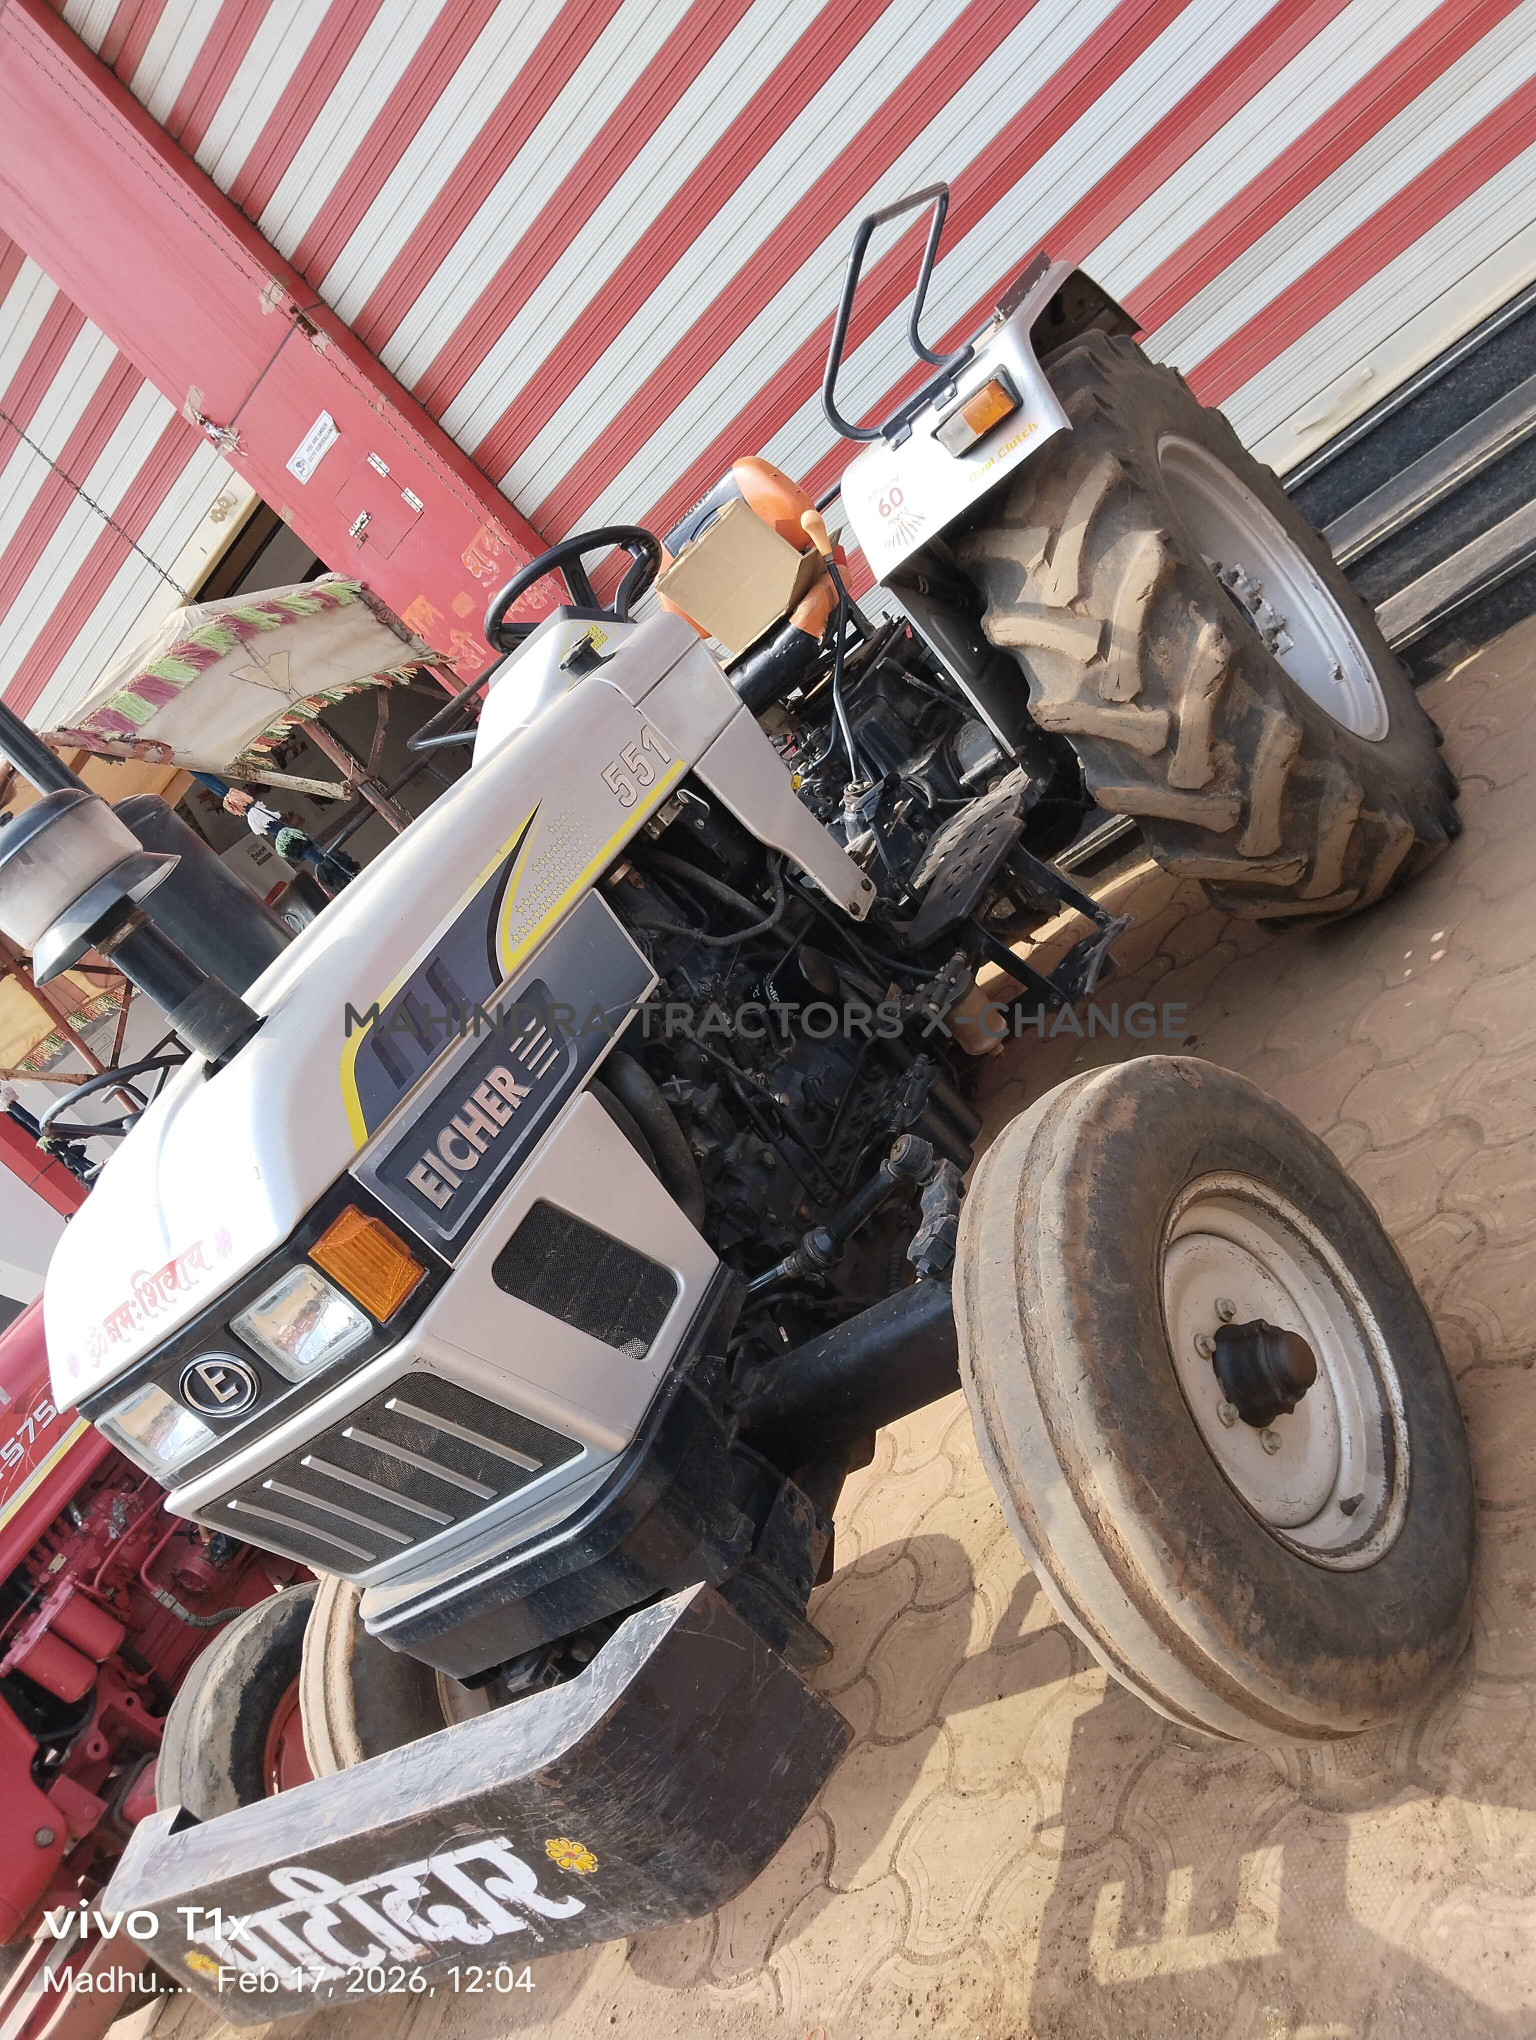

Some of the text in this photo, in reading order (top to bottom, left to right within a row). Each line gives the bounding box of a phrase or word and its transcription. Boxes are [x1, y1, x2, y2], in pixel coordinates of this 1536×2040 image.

[315, 424, 335, 452] SURVEILLANC
[968, 422, 1038, 483] Dual Clutch
[878, 487, 904, 517] 60
[600, 724, 672, 808] 551
[404, 1065, 533, 1210] EICHER
[193, 1836, 586, 1991] पाटीदार
